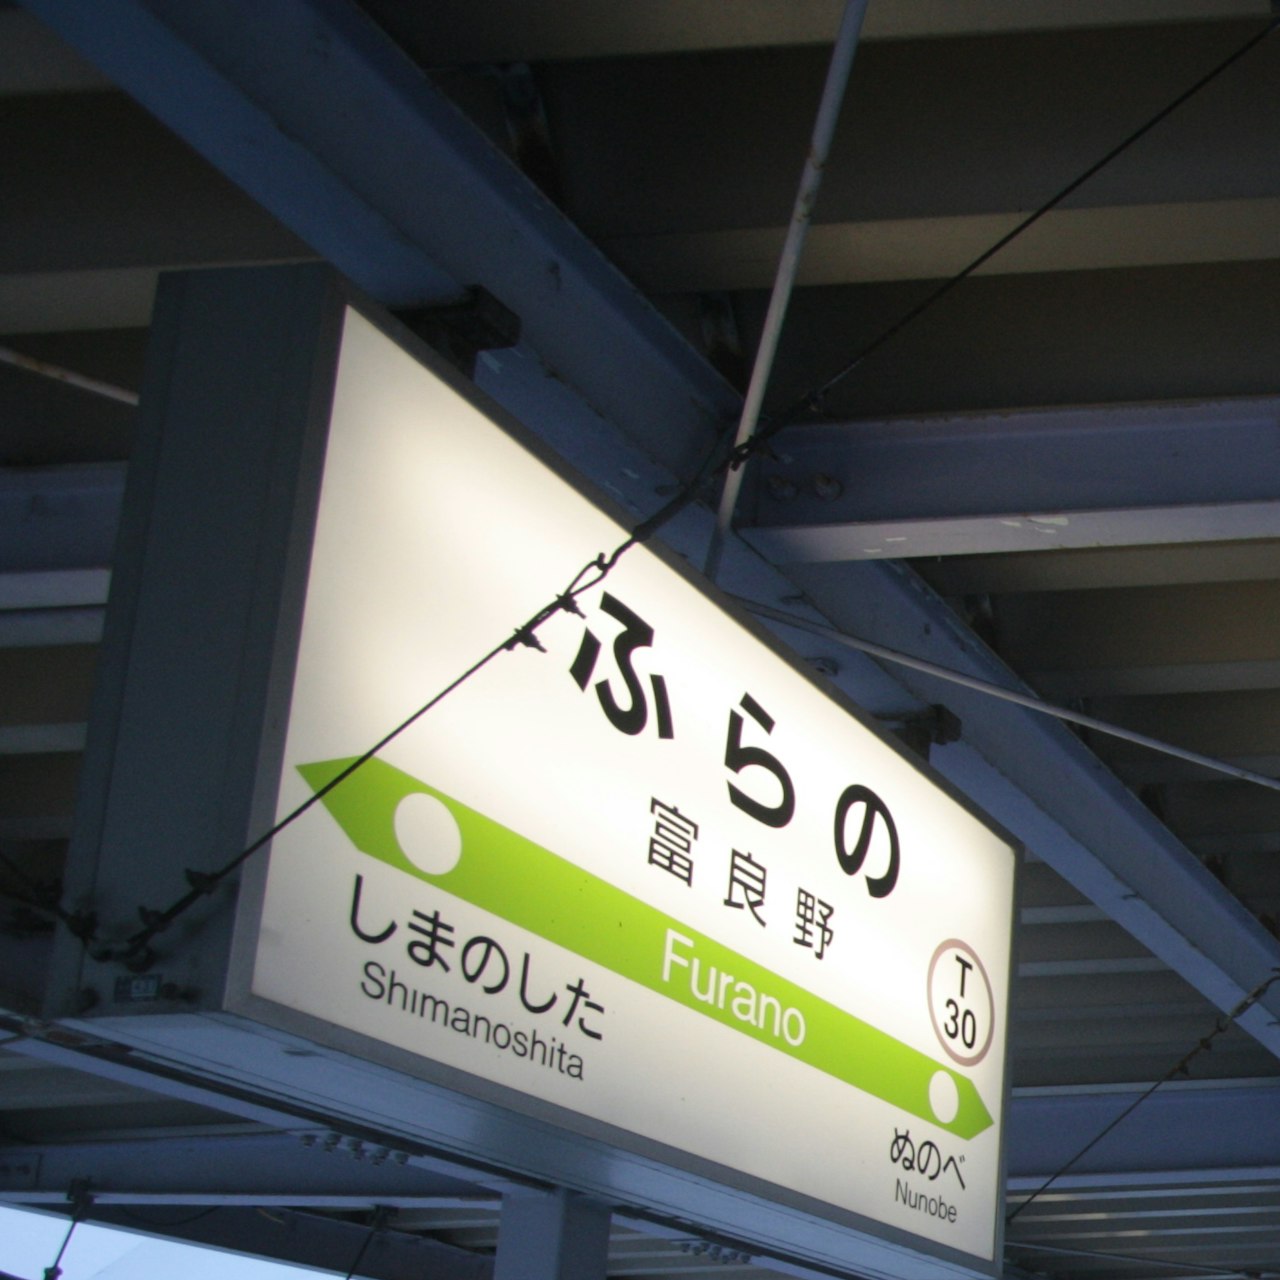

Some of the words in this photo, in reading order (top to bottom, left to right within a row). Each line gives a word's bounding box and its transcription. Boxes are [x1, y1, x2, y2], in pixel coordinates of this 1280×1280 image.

[570, 592, 901, 900] ふらの
[649, 796, 834, 961] 富良野
[351, 875, 605, 1044] しまのした
[662, 929, 806, 1048] Furano
[953, 955, 973, 998] T
[360, 963, 585, 1083] Shimanoshita
[944, 1000, 979, 1050] 30
[890, 1126, 966, 1192] ぬのべ
[894, 1178, 957, 1225] Nunobe
